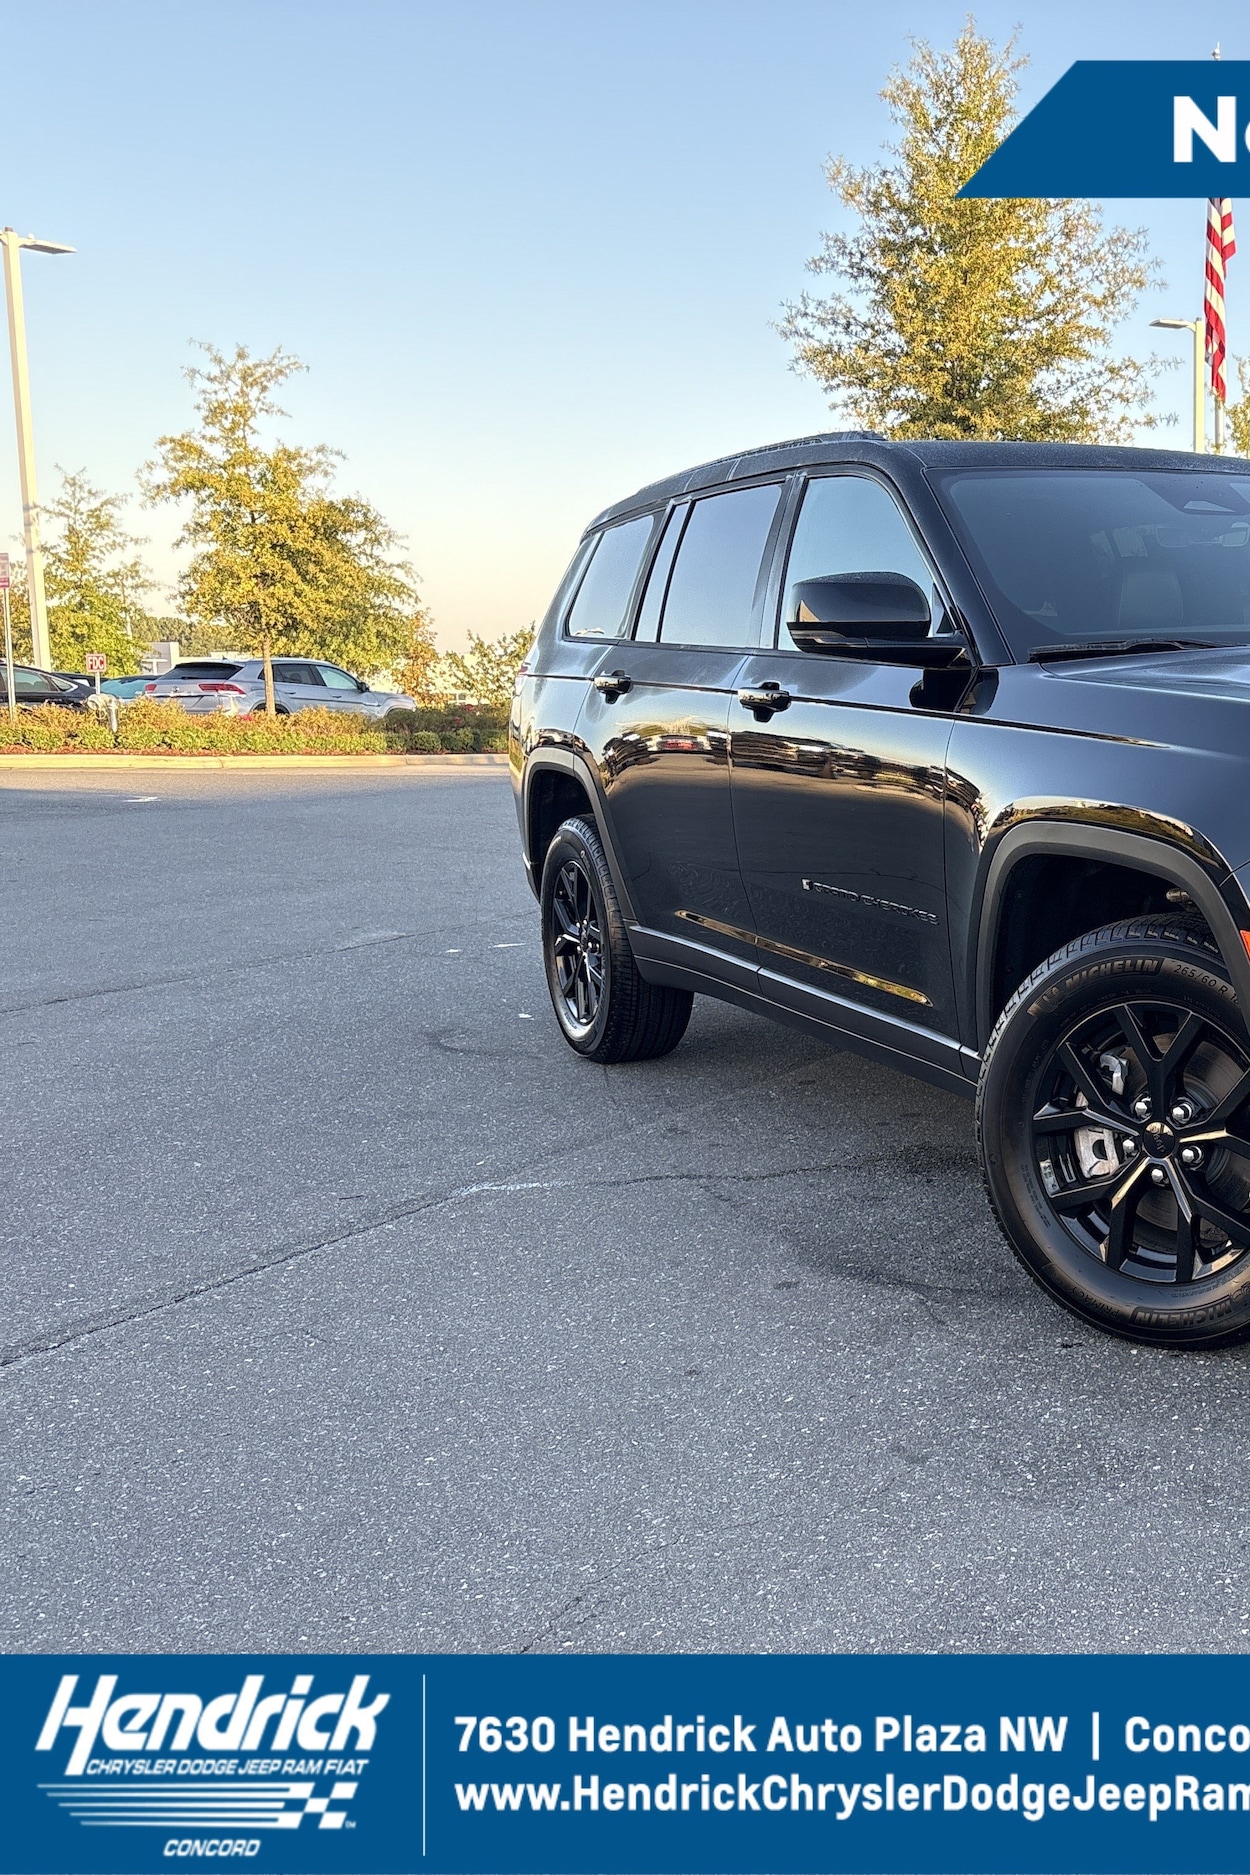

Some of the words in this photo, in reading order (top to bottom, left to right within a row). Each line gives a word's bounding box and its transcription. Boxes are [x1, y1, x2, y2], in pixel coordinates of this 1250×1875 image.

[88, 656, 104, 670] FDC
[1066, 959, 1160, 991] MICHELIN
[1173, 964, 1217, 987] 265/60
[1134, 1300, 1233, 1327] MICHELIN
